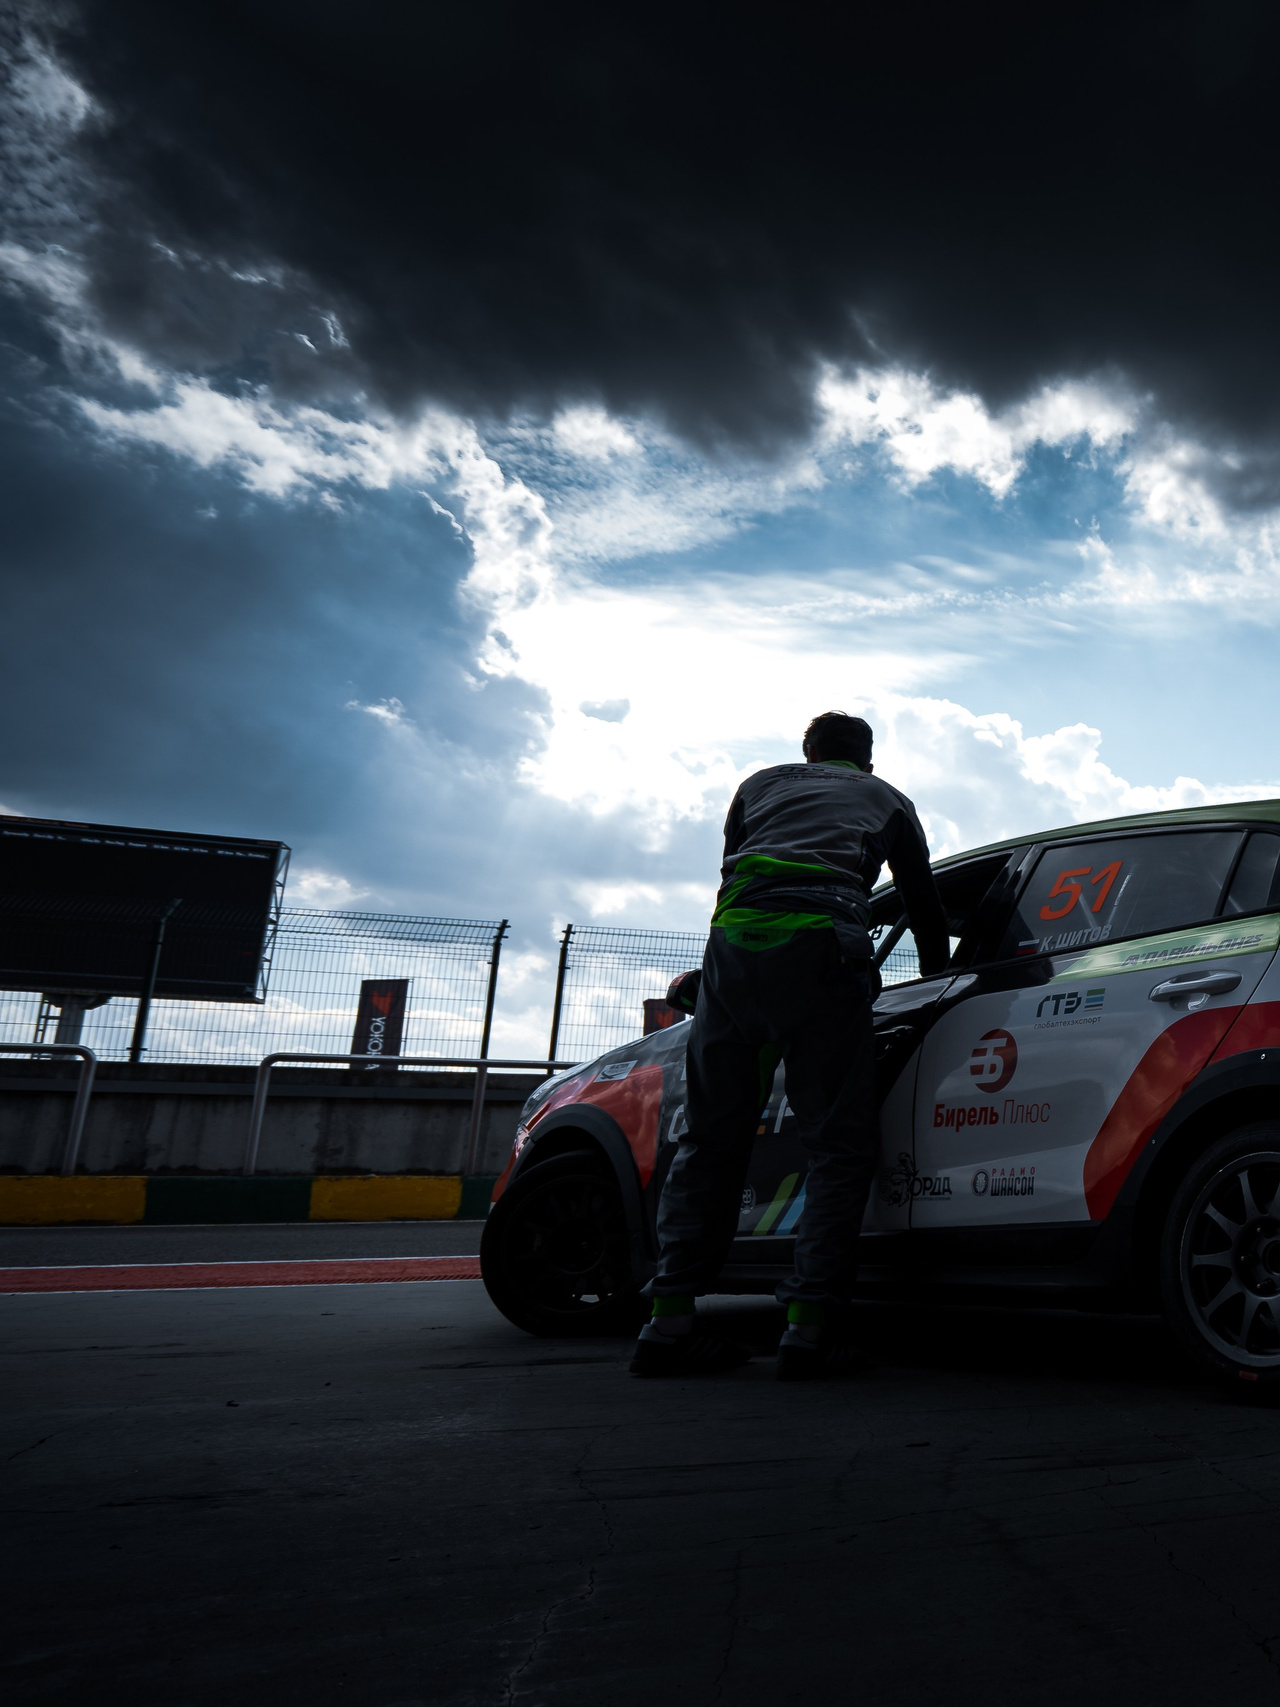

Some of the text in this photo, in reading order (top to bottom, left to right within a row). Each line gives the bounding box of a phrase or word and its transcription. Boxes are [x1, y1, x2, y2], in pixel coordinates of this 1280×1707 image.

[1039, 860, 1124, 921] 51
[1040, 924, 1112, 952] К.ШИТОВ
[1036, 991, 1082, 1018] ГТЭ
[1034, 1016, 1102, 1030] глобалтехэкспорт
[933, 1099, 1051, 1133] Бирель Плюс
[992, 1167, 1036, 1177] РАДИО
[991, 1176, 1034, 1197] ШАНСОН
